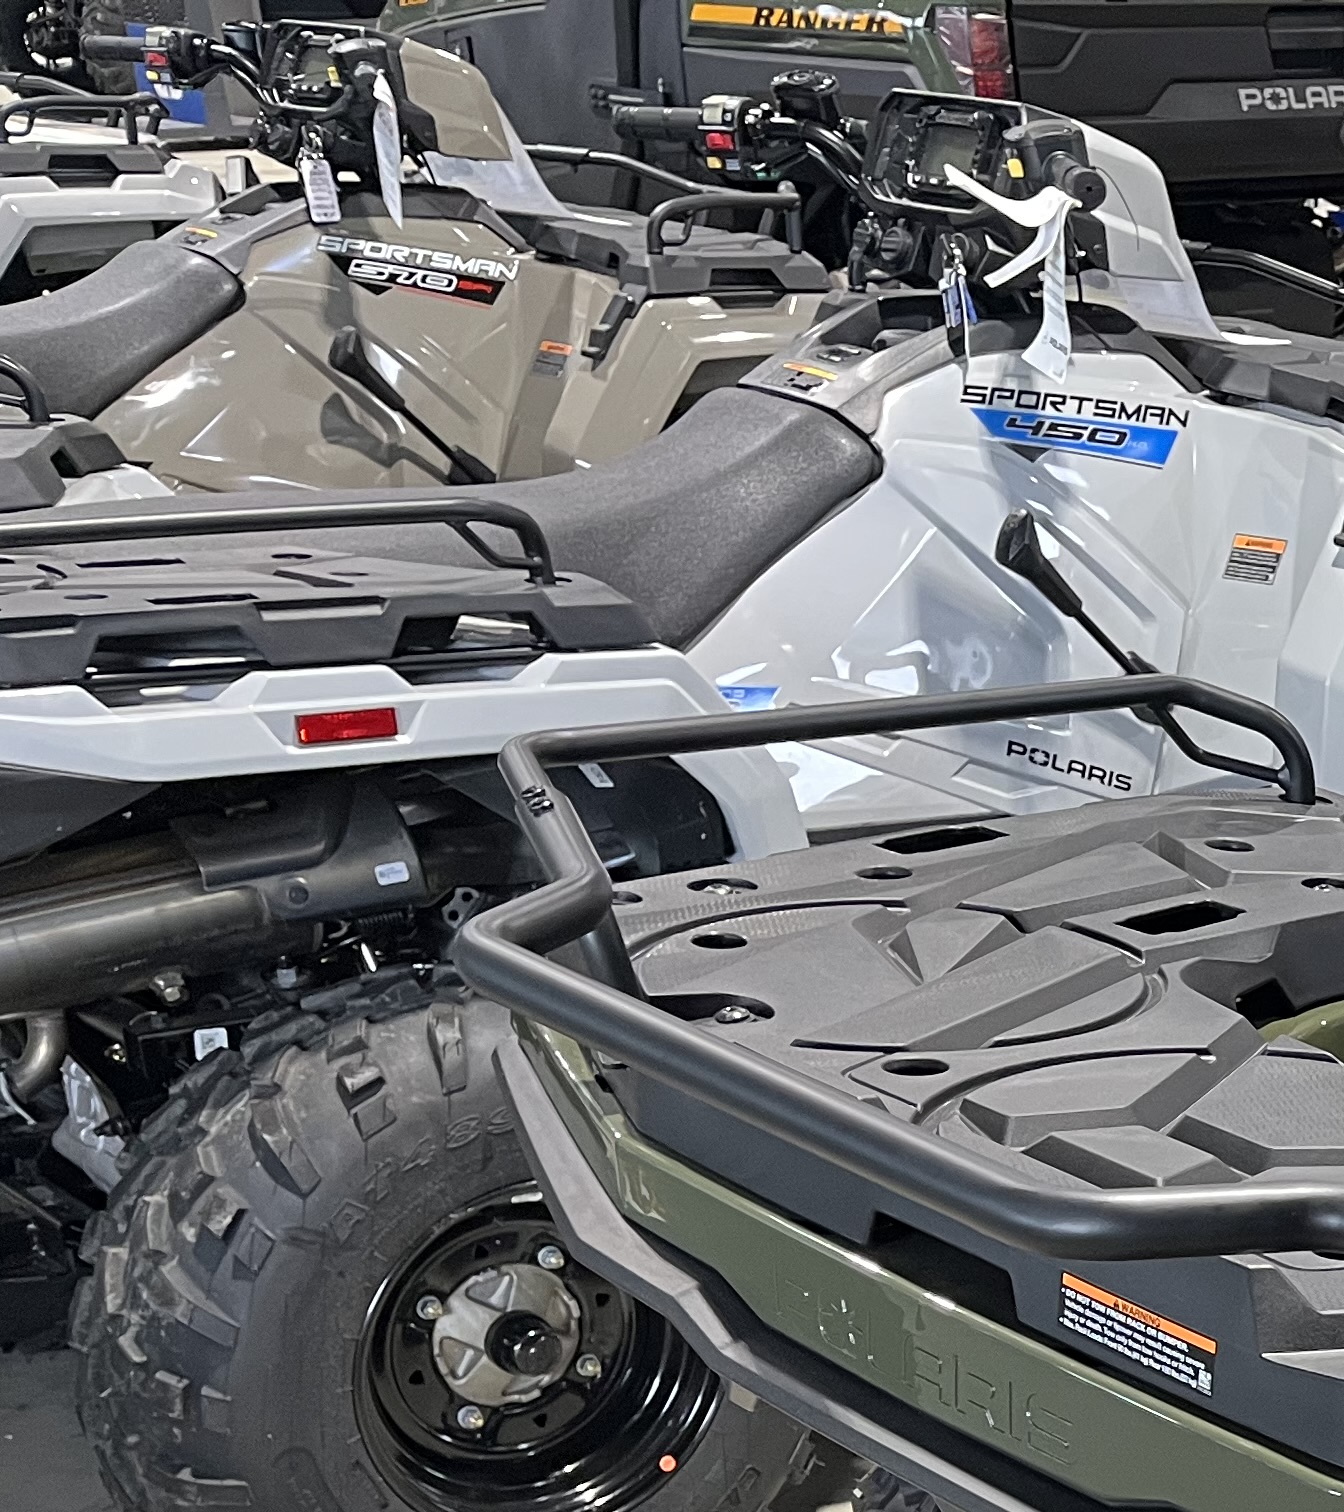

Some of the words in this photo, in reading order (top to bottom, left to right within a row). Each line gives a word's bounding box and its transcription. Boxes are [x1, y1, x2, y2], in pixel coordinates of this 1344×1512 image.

[752, 6, 890, 36] RANGER
[316, 235, 520, 281] SPORTSMAN
[348, 259, 458, 292] 570
[960, 385, 1190, 428] SPORTSMAN
[1004, 416, 1130, 449] 450
[1006, 739, 1133, 792] POLARIS
[1121, 1302, 1162, 1328] WARNING
